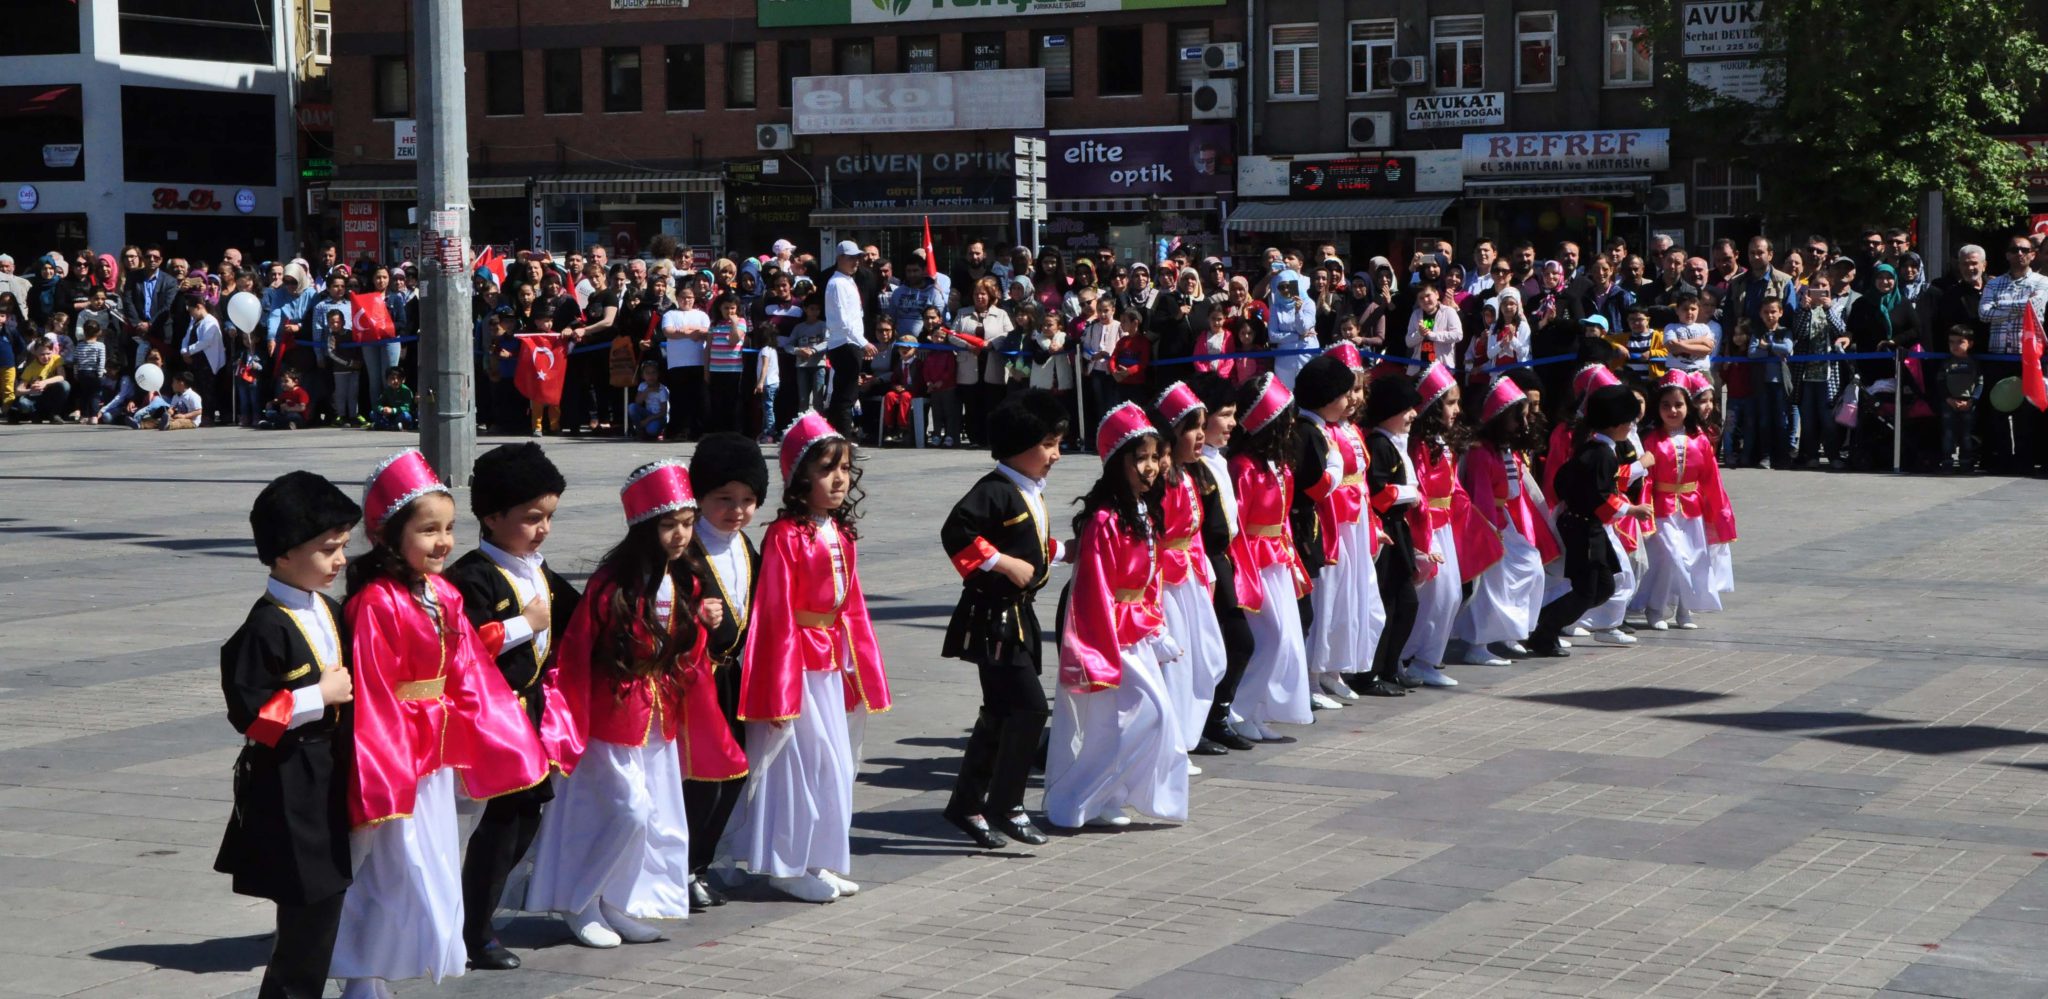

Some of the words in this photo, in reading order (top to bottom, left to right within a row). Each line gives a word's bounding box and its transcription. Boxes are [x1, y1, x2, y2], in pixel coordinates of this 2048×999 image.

[1685, 31, 1718, 42] Serhat
[1726, 43, 1743, 51] 225
[803, 76, 953, 109] ekol
[1414, 95, 1496, 111] AVUKAT
[1064, 140, 1124, 164] elite
[1488, 131, 1642, 158] REFREF
[1109, 163, 1173, 188] optik
[344, 217, 378, 233] ECZANESİ
